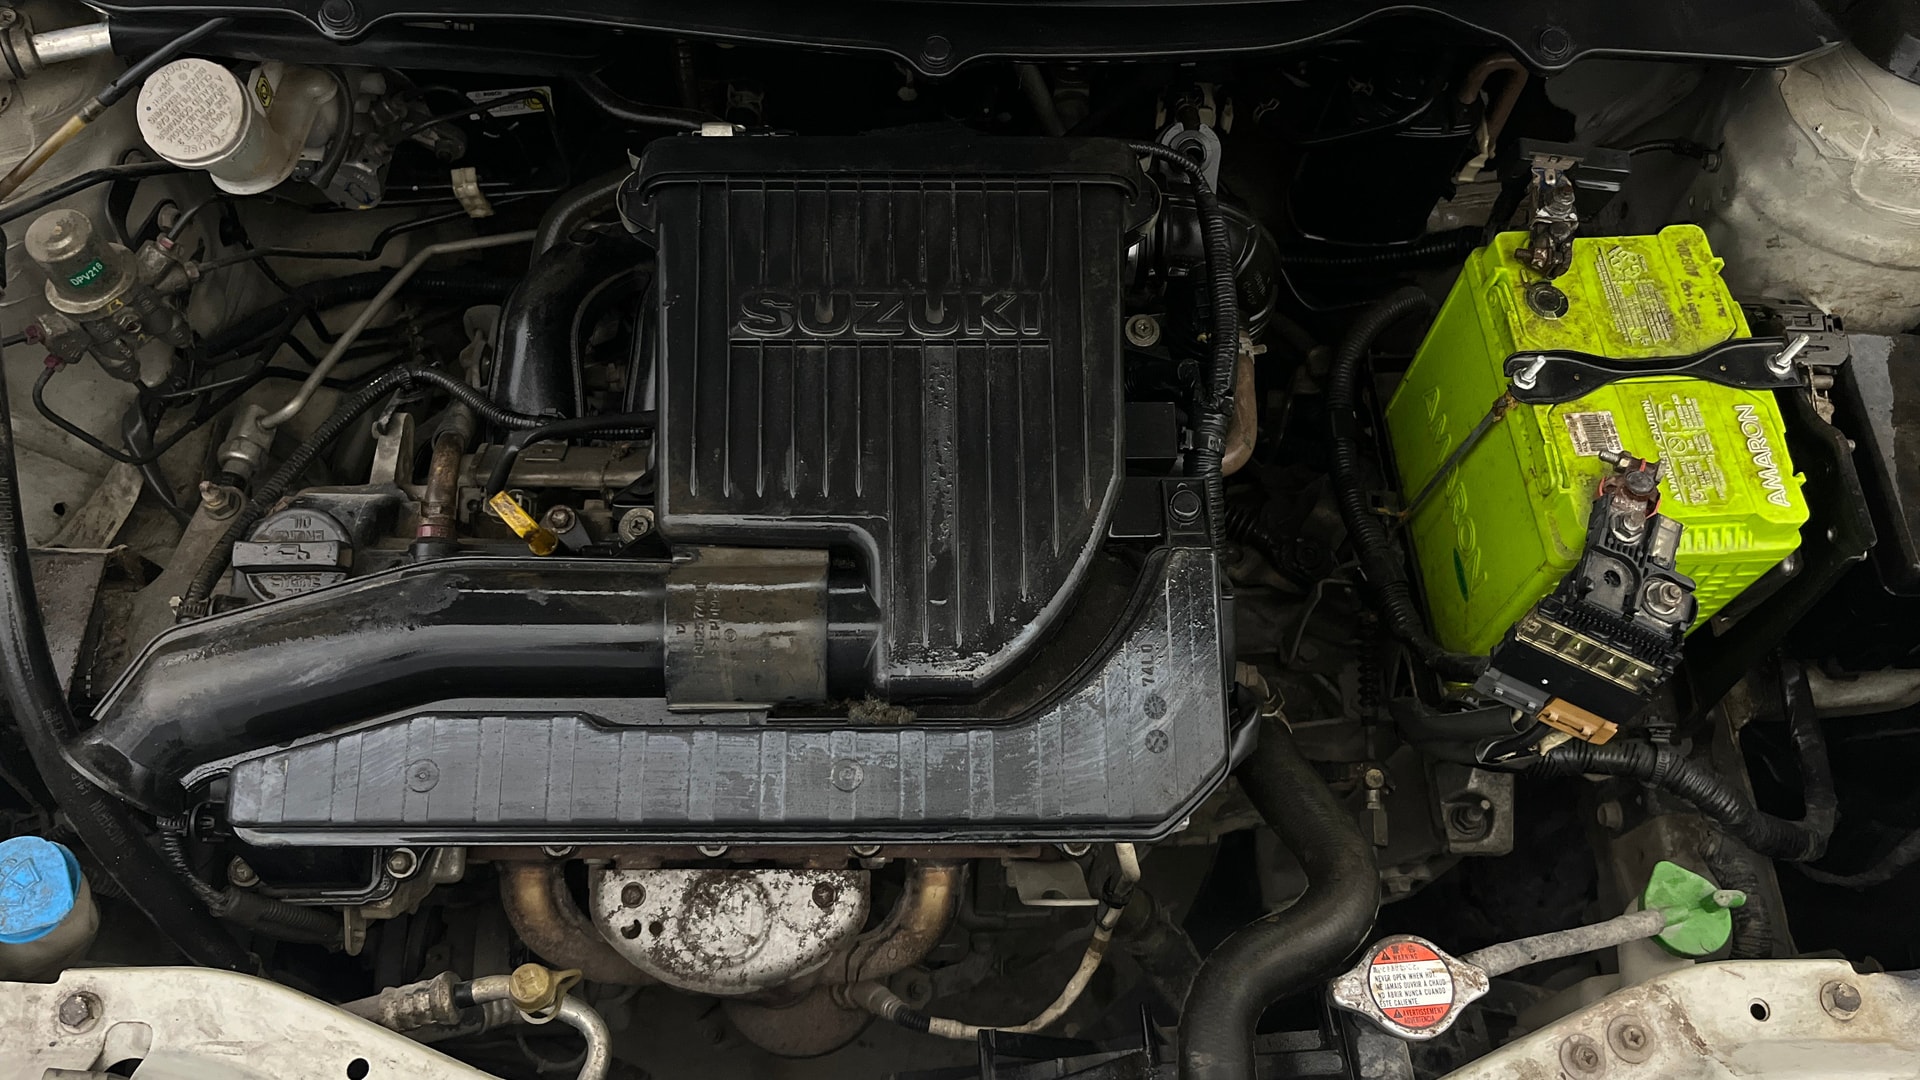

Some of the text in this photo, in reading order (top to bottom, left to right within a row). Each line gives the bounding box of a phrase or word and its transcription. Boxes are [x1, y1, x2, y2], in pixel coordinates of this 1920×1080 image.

[181, 67, 205, 92] BEFORE
[189, 73, 211, 96] CLEAN
[169, 94, 190, 116] FILLER
[192, 81, 216, 107] SEALED
[186, 106, 205, 126] FLUID
[184, 132, 220, 153] CLOSE
[70, 262, 103, 286] DPV218
[738, 290, 1044, 336] SUZUKI
[1641, 400, 1662, 443] CAUTION
[1734, 404, 1790, 507] AMARON
[290, 516, 312, 528] OIL
[1140, 643, 1154, 687] 74L0
[1374, 974, 1392, 982] NEVER
[1402, 1006, 1444, 1017] AVERTISSEMENT
